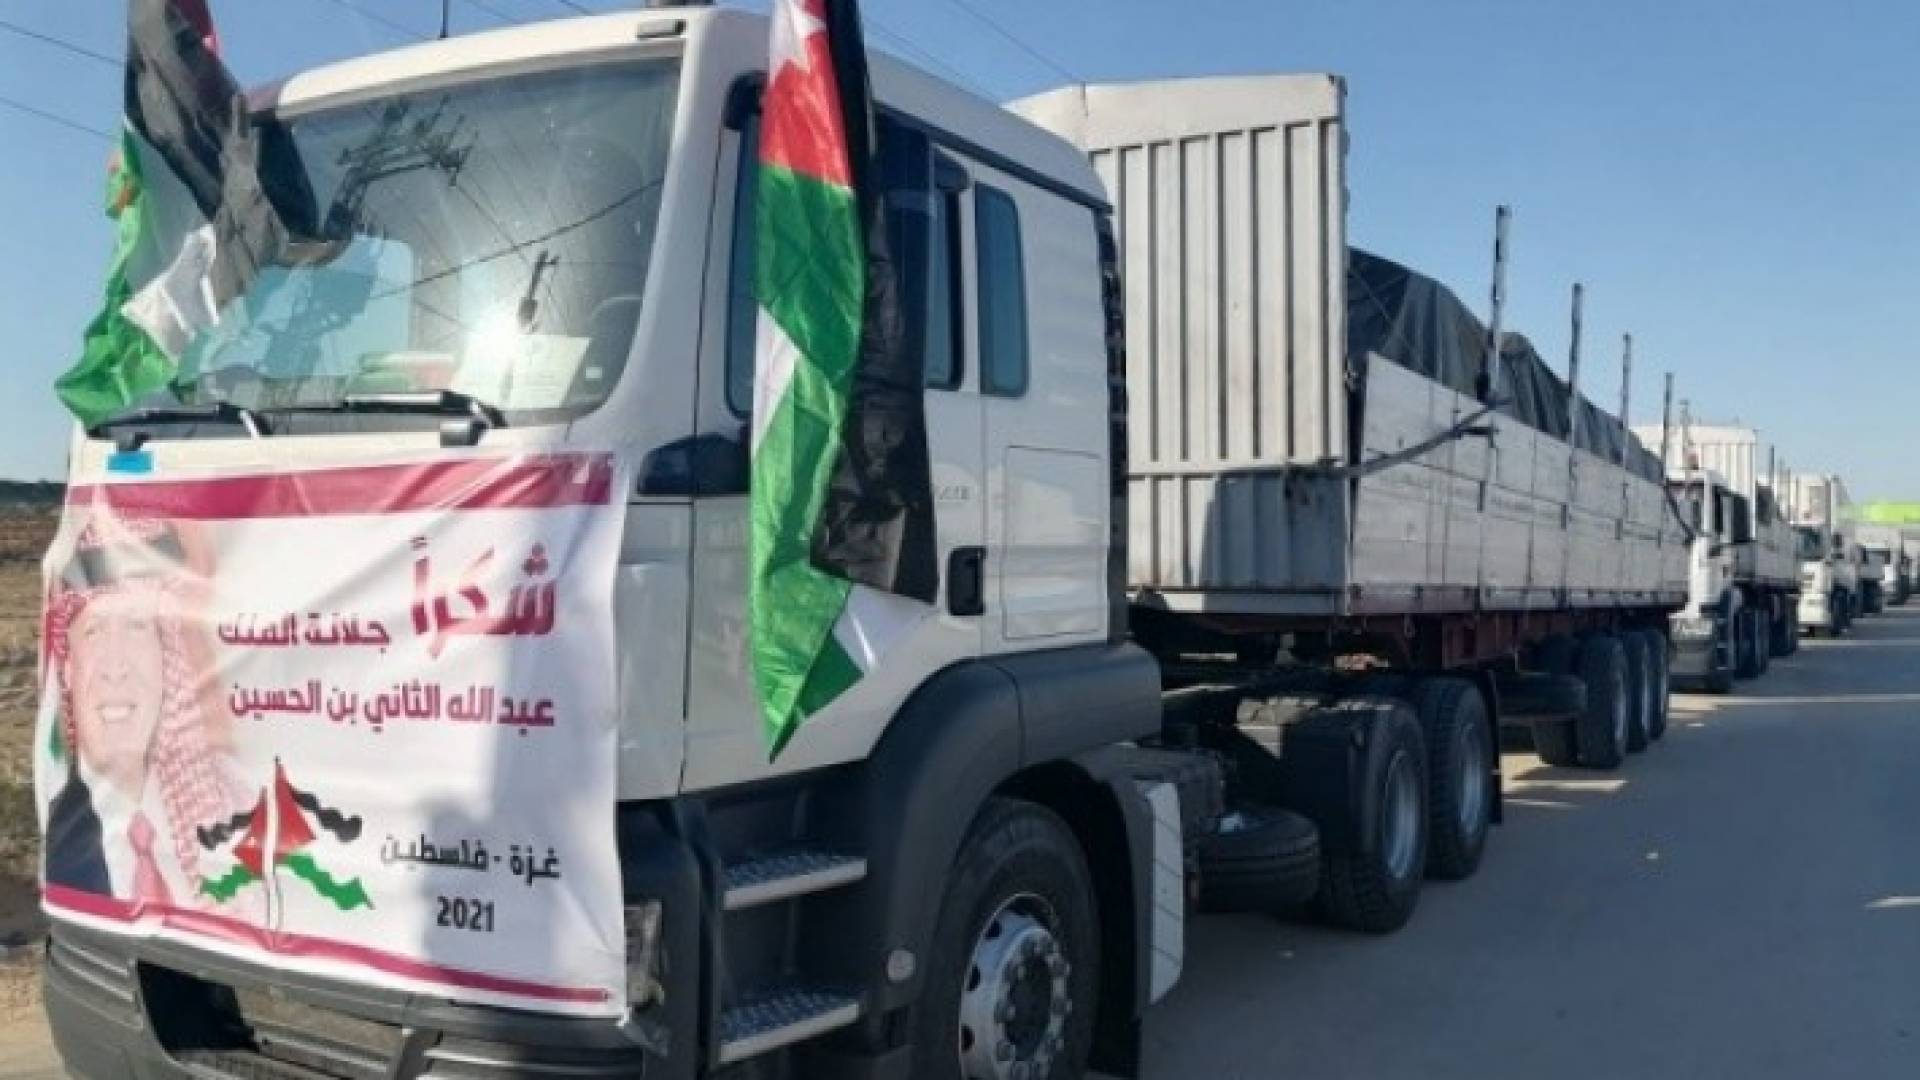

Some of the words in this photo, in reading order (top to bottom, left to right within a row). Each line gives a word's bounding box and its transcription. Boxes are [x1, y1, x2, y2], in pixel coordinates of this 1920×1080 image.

[218, 612, 298, 646] الملك
[230, 679, 321, 721] الحسين
[327, 686, 358, 725] بن
[364, 678, 441, 732] الثاني
[448, 684, 494, 723] الله
[497, 696, 554, 737] عبد
[380, 832, 488, 872] فلسطين
[509, 843, 560, 886] غزة
[436, 895, 495, 932] 2021
